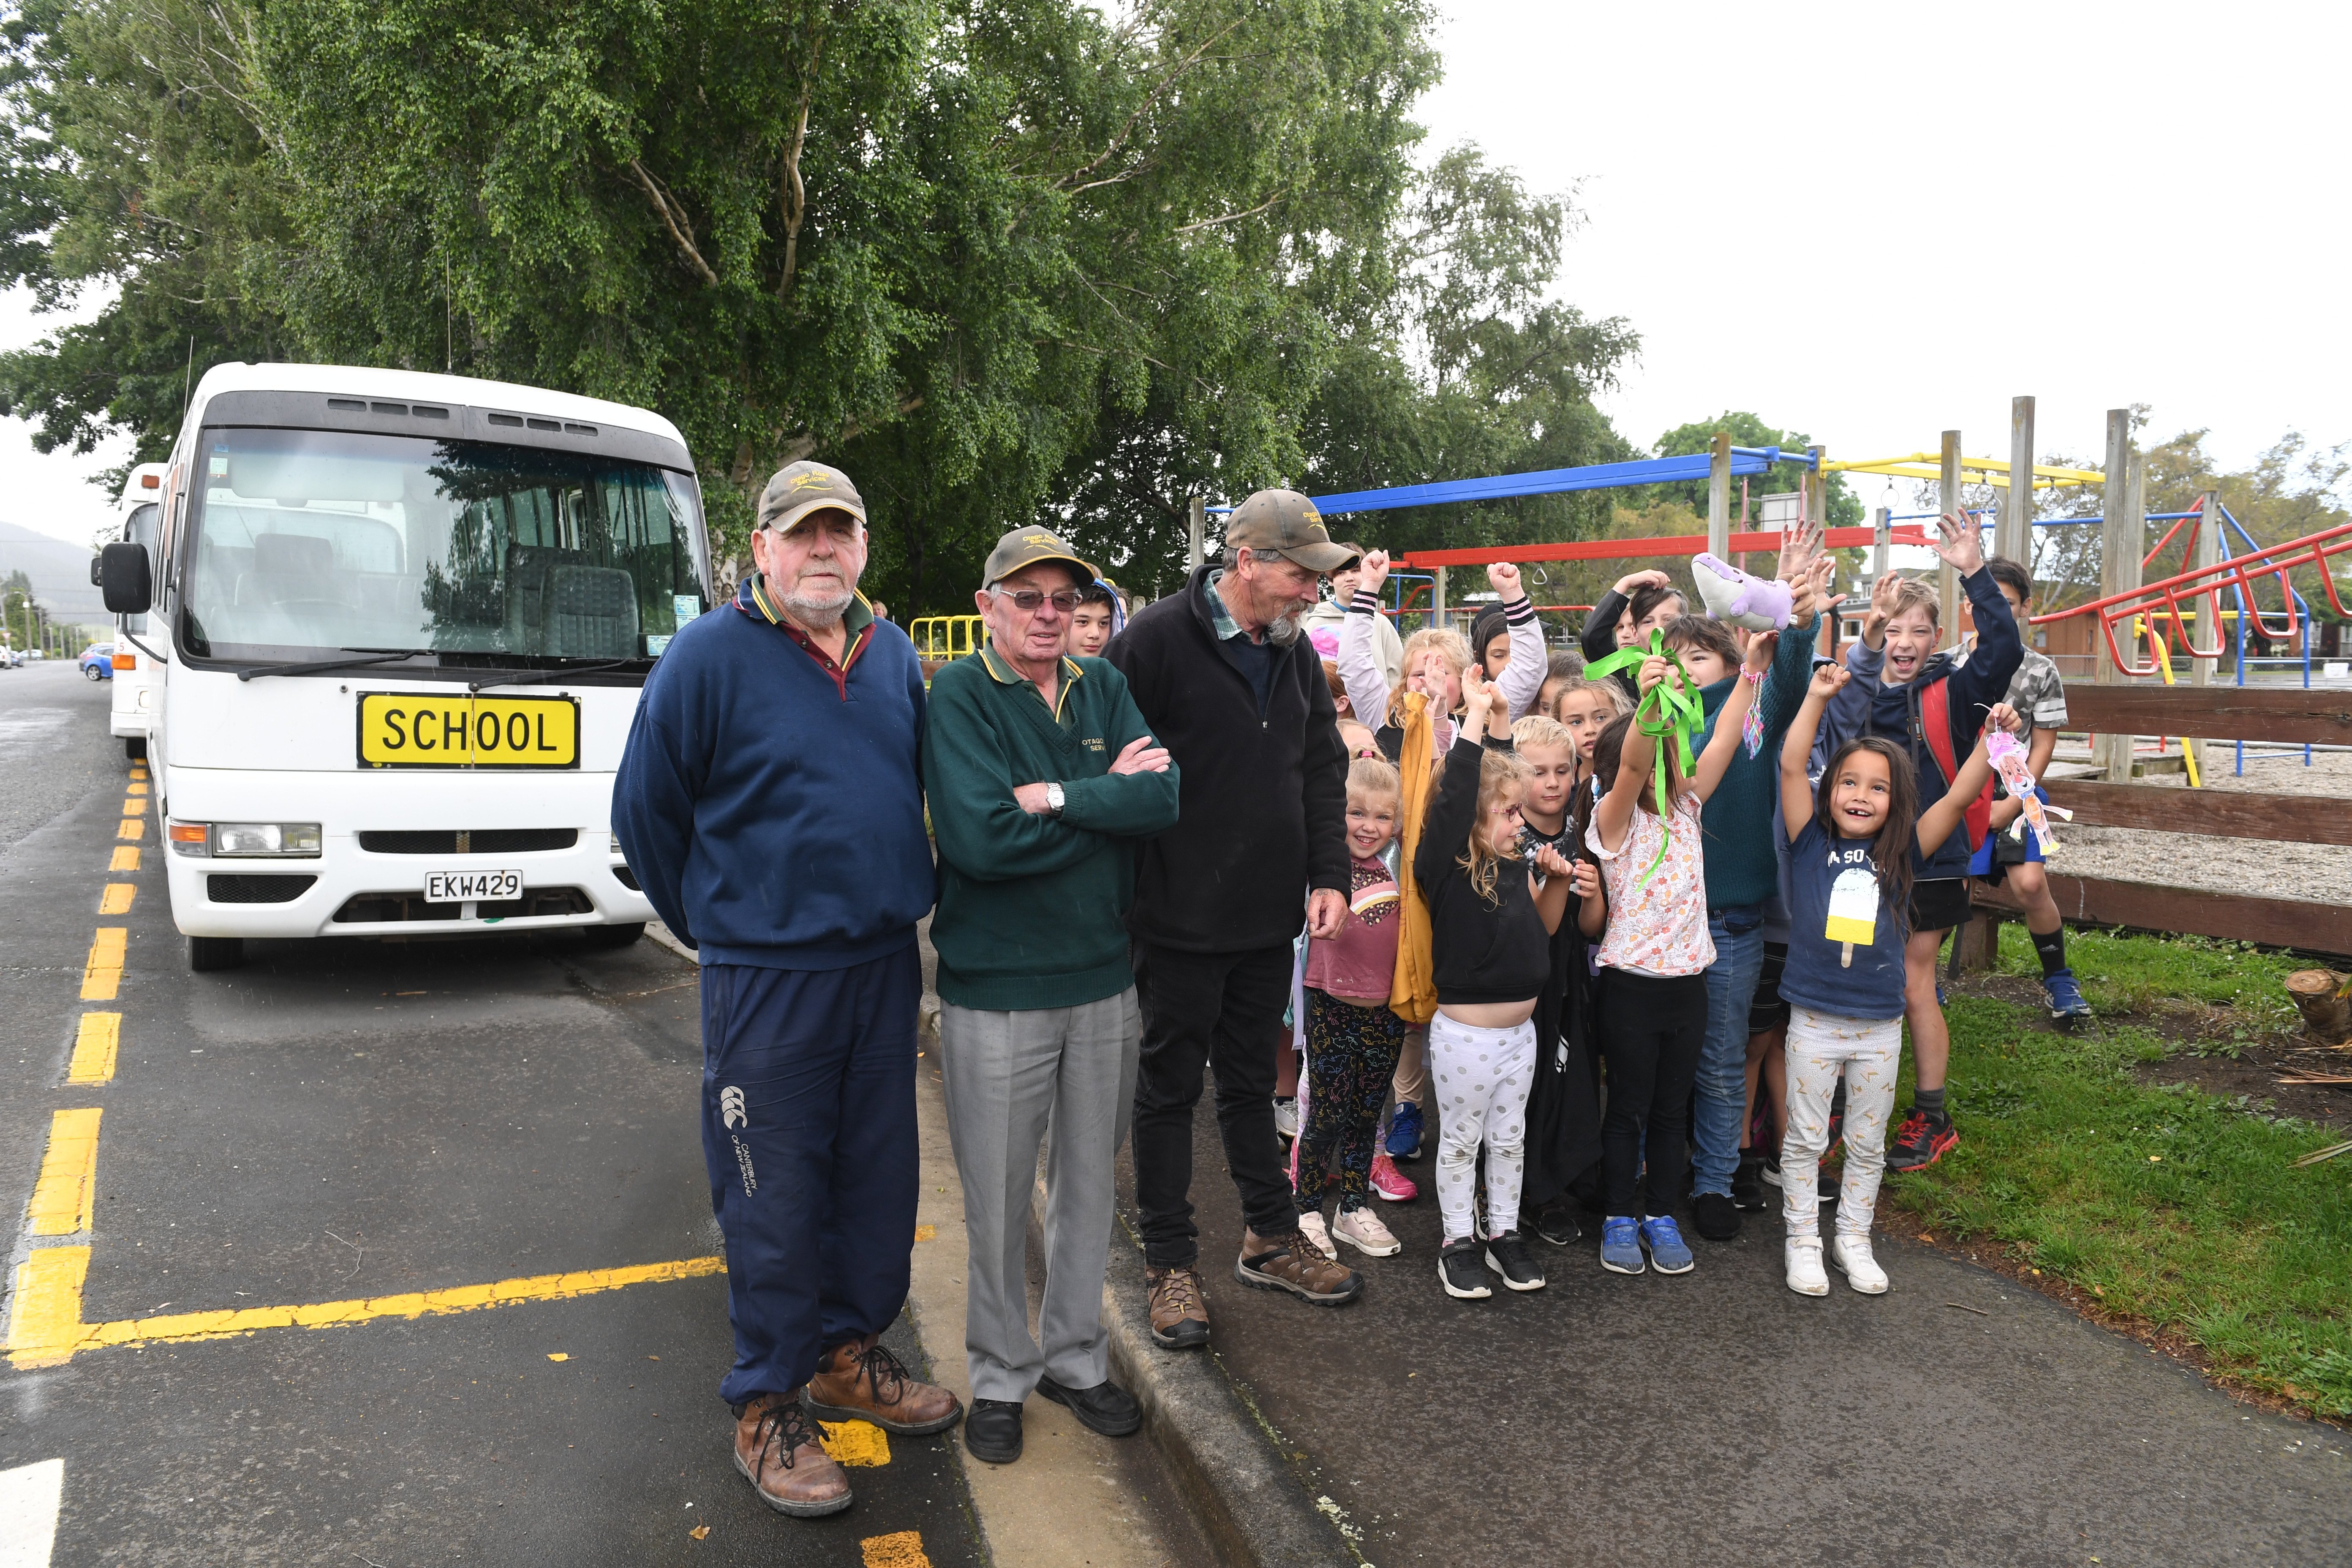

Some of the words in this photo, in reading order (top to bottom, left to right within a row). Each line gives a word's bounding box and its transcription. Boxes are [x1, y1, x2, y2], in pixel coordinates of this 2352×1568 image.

[790, 473, 810, 484] Otago
[797, 476, 826, 485] Services
[1030, 538, 1056, 546] Services
[119, 642, 124, 651] 5
[382, 709, 558, 751] SCHOOL
[1844, 849, 1865, 864] SO
[429, 874, 518, 898] EKW429
[731, 1135, 740, 1146] OF
[735, 1146, 744, 1163] NEW
[741, 1143, 758, 1190] CANTERBURY
[739, 1163, 752, 1198] ZEALAND
